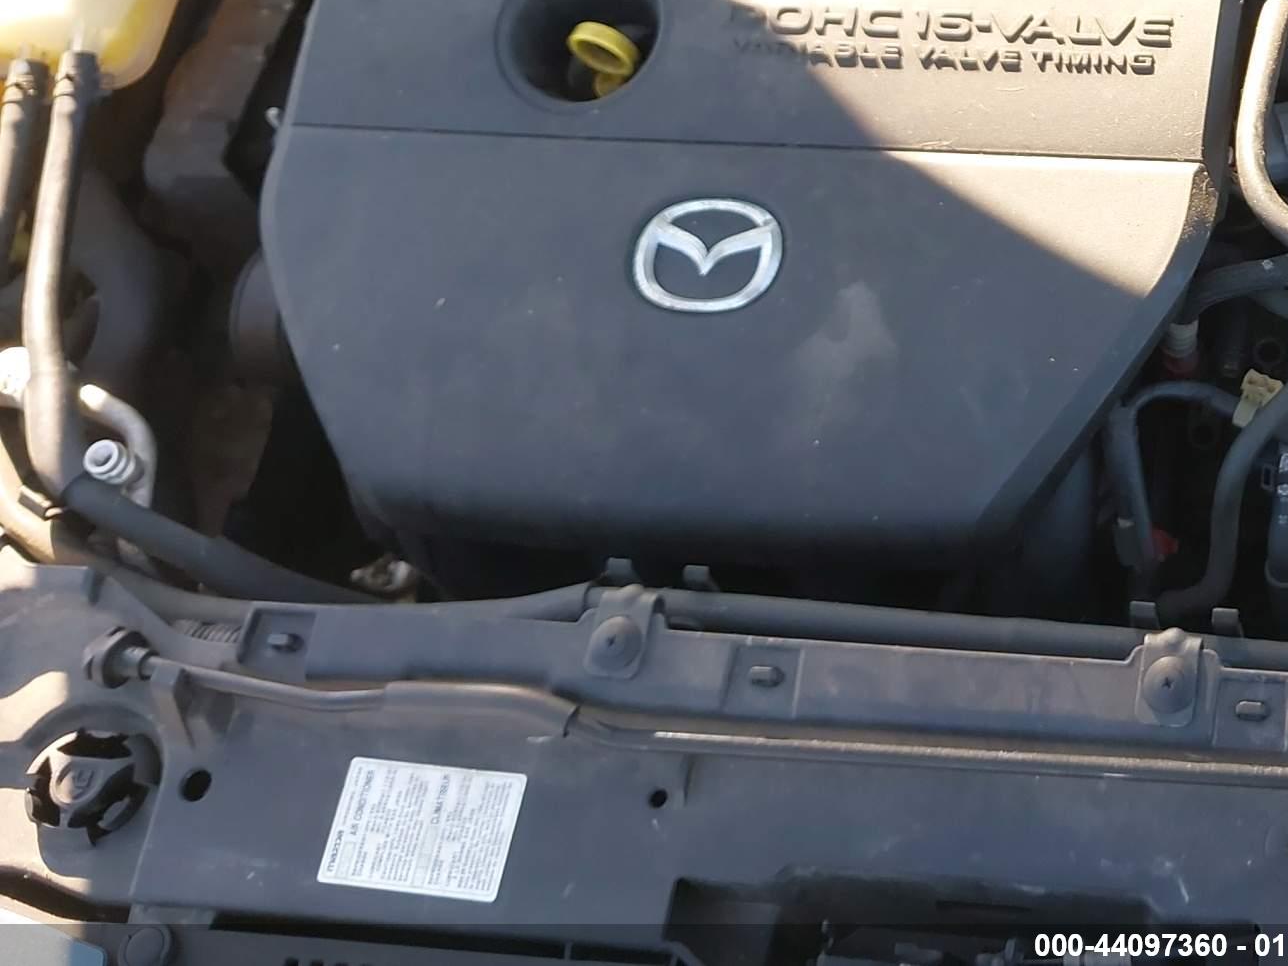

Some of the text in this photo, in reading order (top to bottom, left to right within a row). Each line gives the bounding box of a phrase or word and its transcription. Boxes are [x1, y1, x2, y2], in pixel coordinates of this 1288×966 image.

[915, 10, 1175, 49] 16-VALVE
[914, 46, 1023, 73] VALVE
[1030, 48, 1157, 76] TIMING
